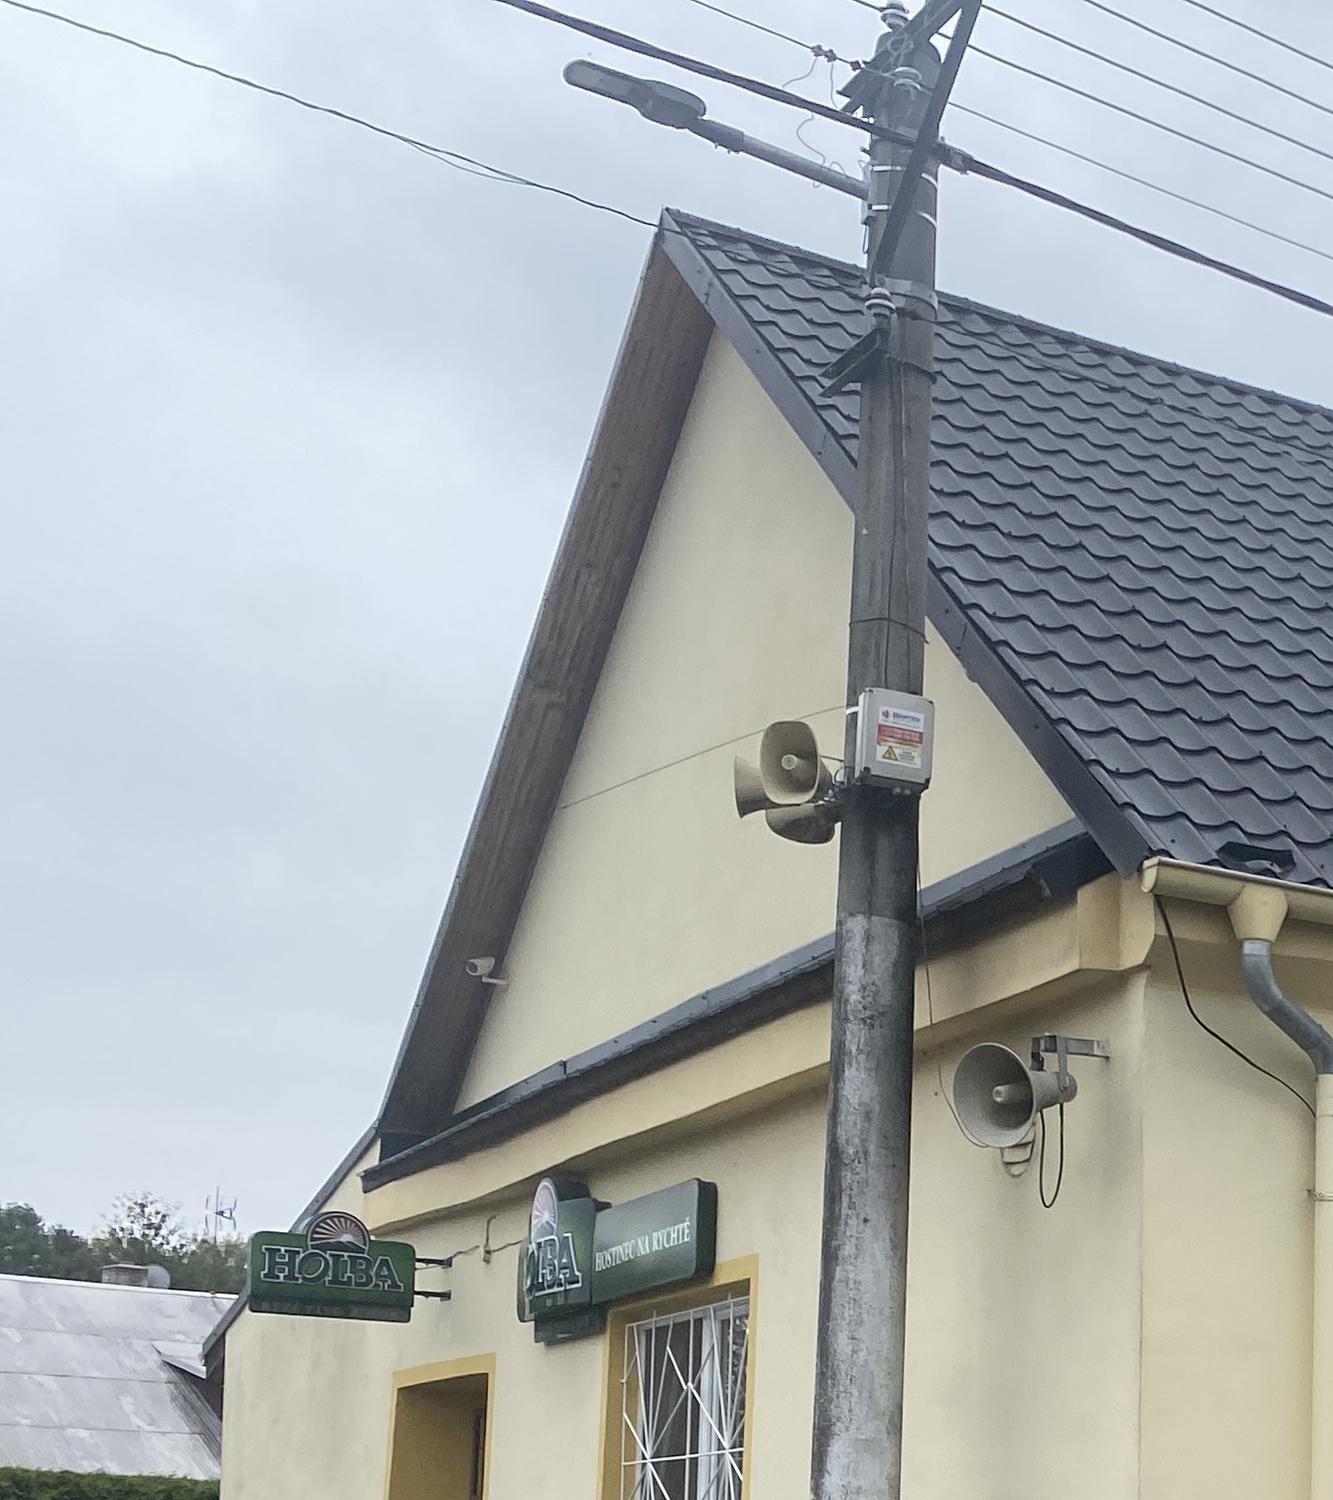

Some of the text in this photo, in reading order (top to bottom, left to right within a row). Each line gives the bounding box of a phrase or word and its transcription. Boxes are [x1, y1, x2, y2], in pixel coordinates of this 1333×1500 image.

[261, 1245, 404, 1292] HOLBA
[595, 1240, 635, 1271] HOSTINEC
[636, 1235, 650, 1257] NA
